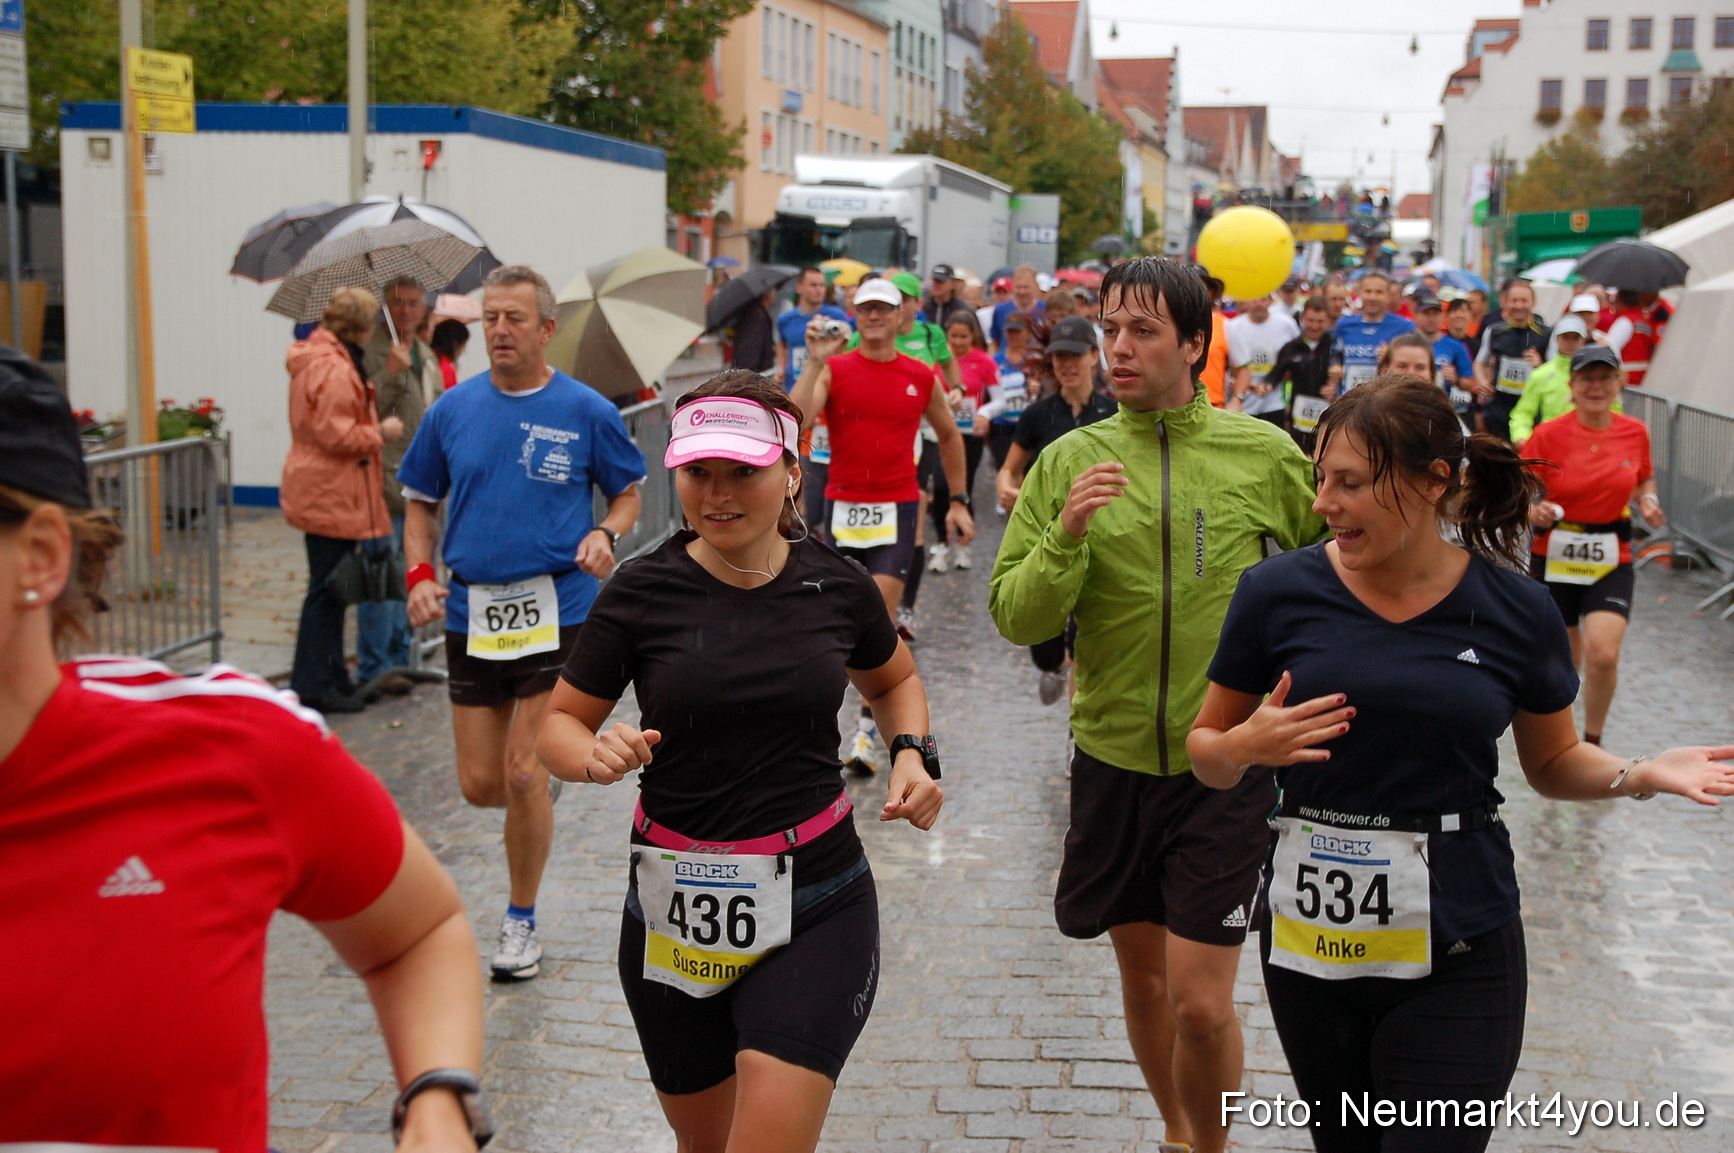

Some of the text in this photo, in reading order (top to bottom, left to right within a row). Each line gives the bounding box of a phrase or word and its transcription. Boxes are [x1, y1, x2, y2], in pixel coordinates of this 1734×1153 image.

[847, 506, 883, 527] 825
[1195, 508, 1205, 578] SALOMON
[1562, 542, 1605, 563] 445
[485, 599, 540, 633] 625
[1299, 805, 1391, 828] www.tripower.de
[1310, 833, 1372, 856] BOCK
[675, 861, 740, 879] BOCK
[1295, 862, 1394, 926] 534
[667, 890, 757, 949] 436
[1315, 934, 1367, 959] Anke
